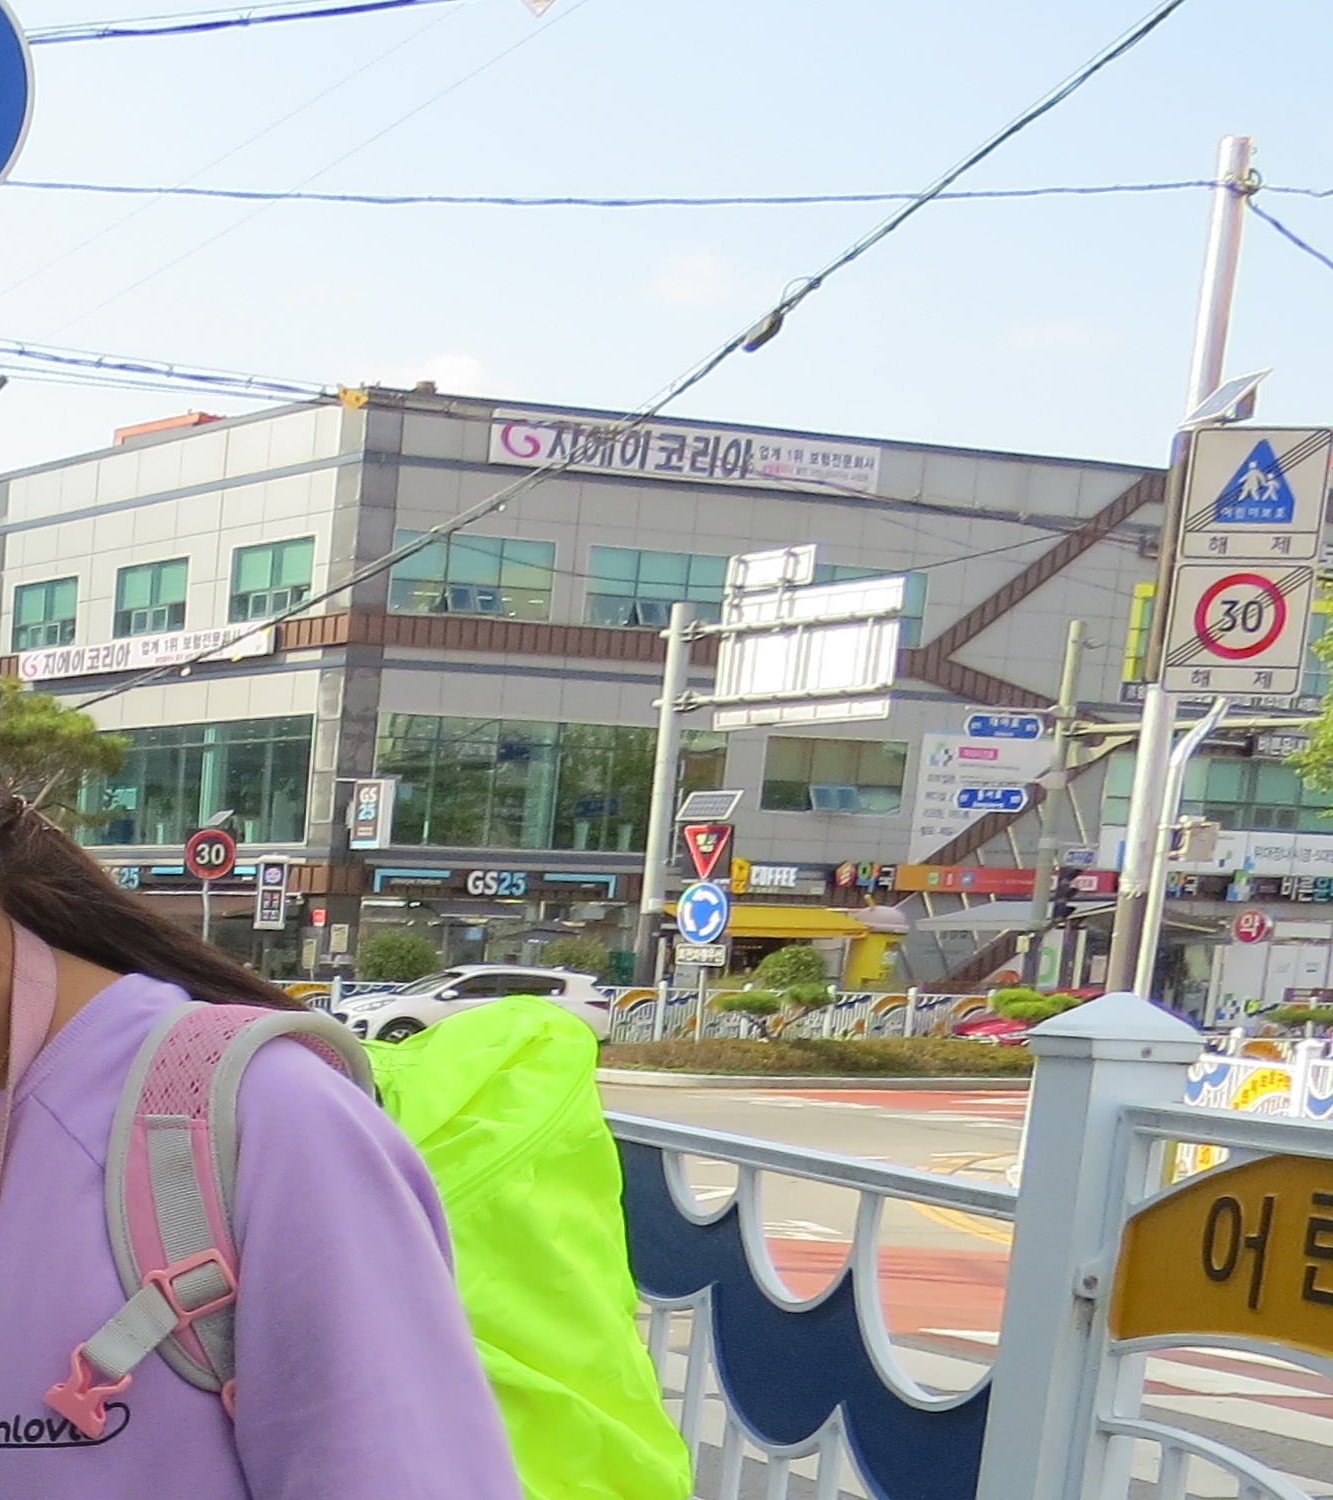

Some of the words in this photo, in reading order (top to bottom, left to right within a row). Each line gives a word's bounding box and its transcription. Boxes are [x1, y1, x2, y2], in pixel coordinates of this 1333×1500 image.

[1218, 600, 1264, 633] 30
[42, 644, 131, 676] 지에이코리아
[359, 786, 378, 803] GS
[358, 803, 377, 821] 25
[195, 843, 226, 866] 30
[466, 870, 529, 896] GS25
[750, 865, 799, 888] COFFEE
